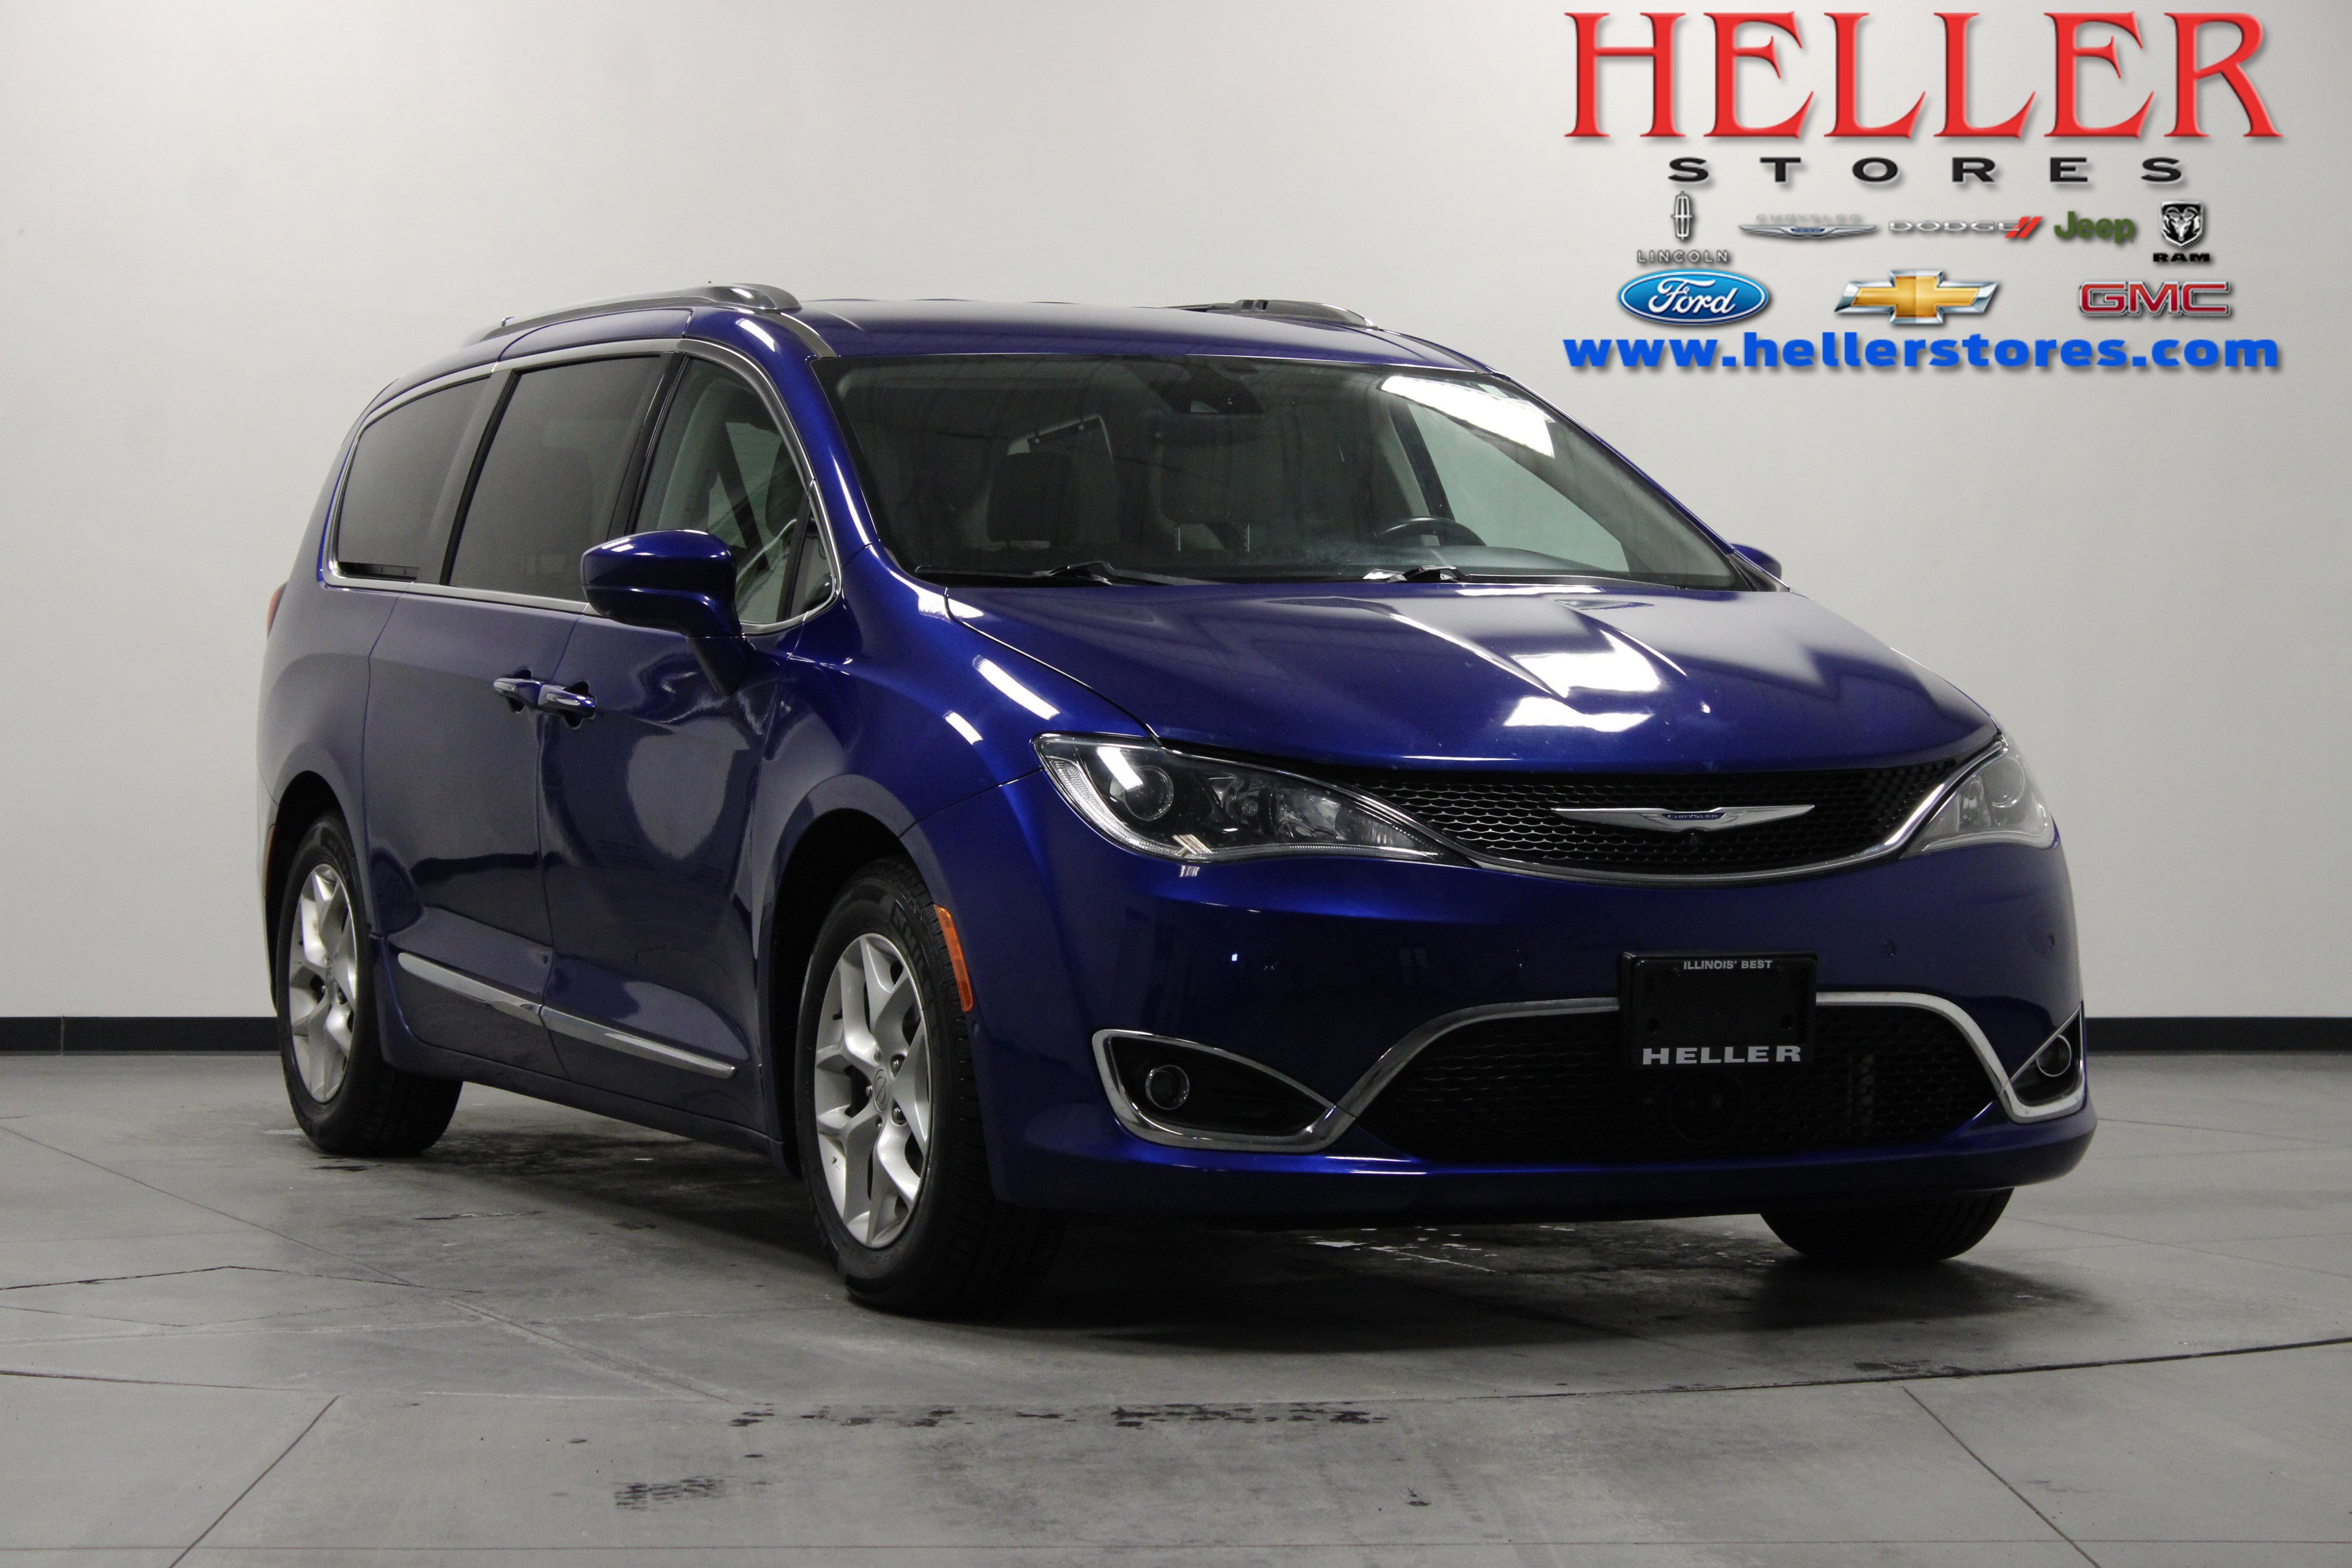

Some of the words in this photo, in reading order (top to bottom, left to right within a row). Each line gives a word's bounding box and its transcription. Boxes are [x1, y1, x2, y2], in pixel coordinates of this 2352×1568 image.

[1683, 960, 1737, 970] ILLINOIS'
[1741, 959, 1773, 969] BEST
[1642, 1045, 1801, 1065] HELLER
